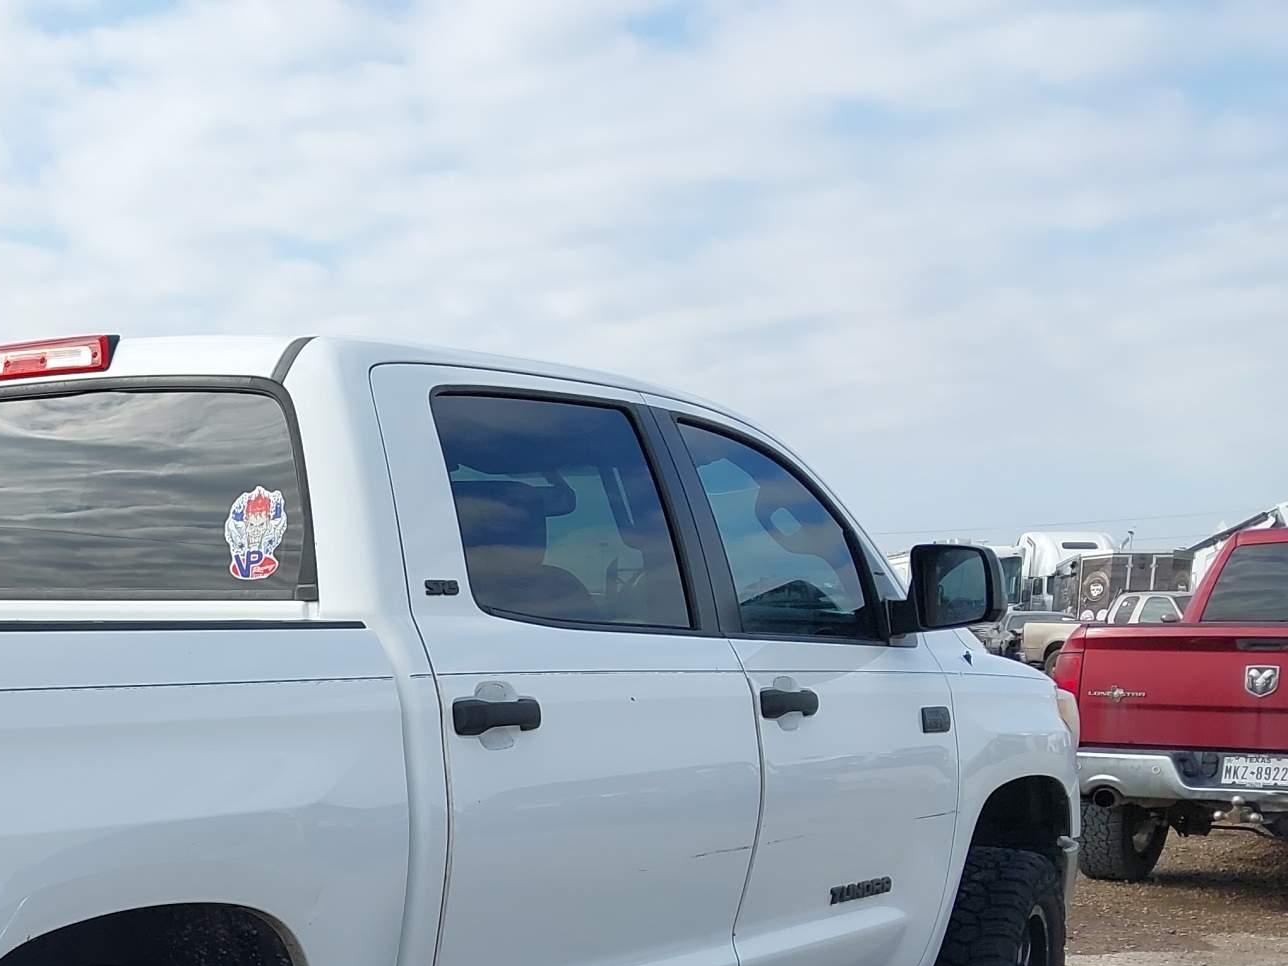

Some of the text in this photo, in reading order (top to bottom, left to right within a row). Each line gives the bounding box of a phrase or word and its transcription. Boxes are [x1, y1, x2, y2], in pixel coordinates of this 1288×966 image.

[234, 551, 263, 577] VP
[1244, 756, 1272, 764] TEXAS
[830, 876, 892, 905] TUNDRA
